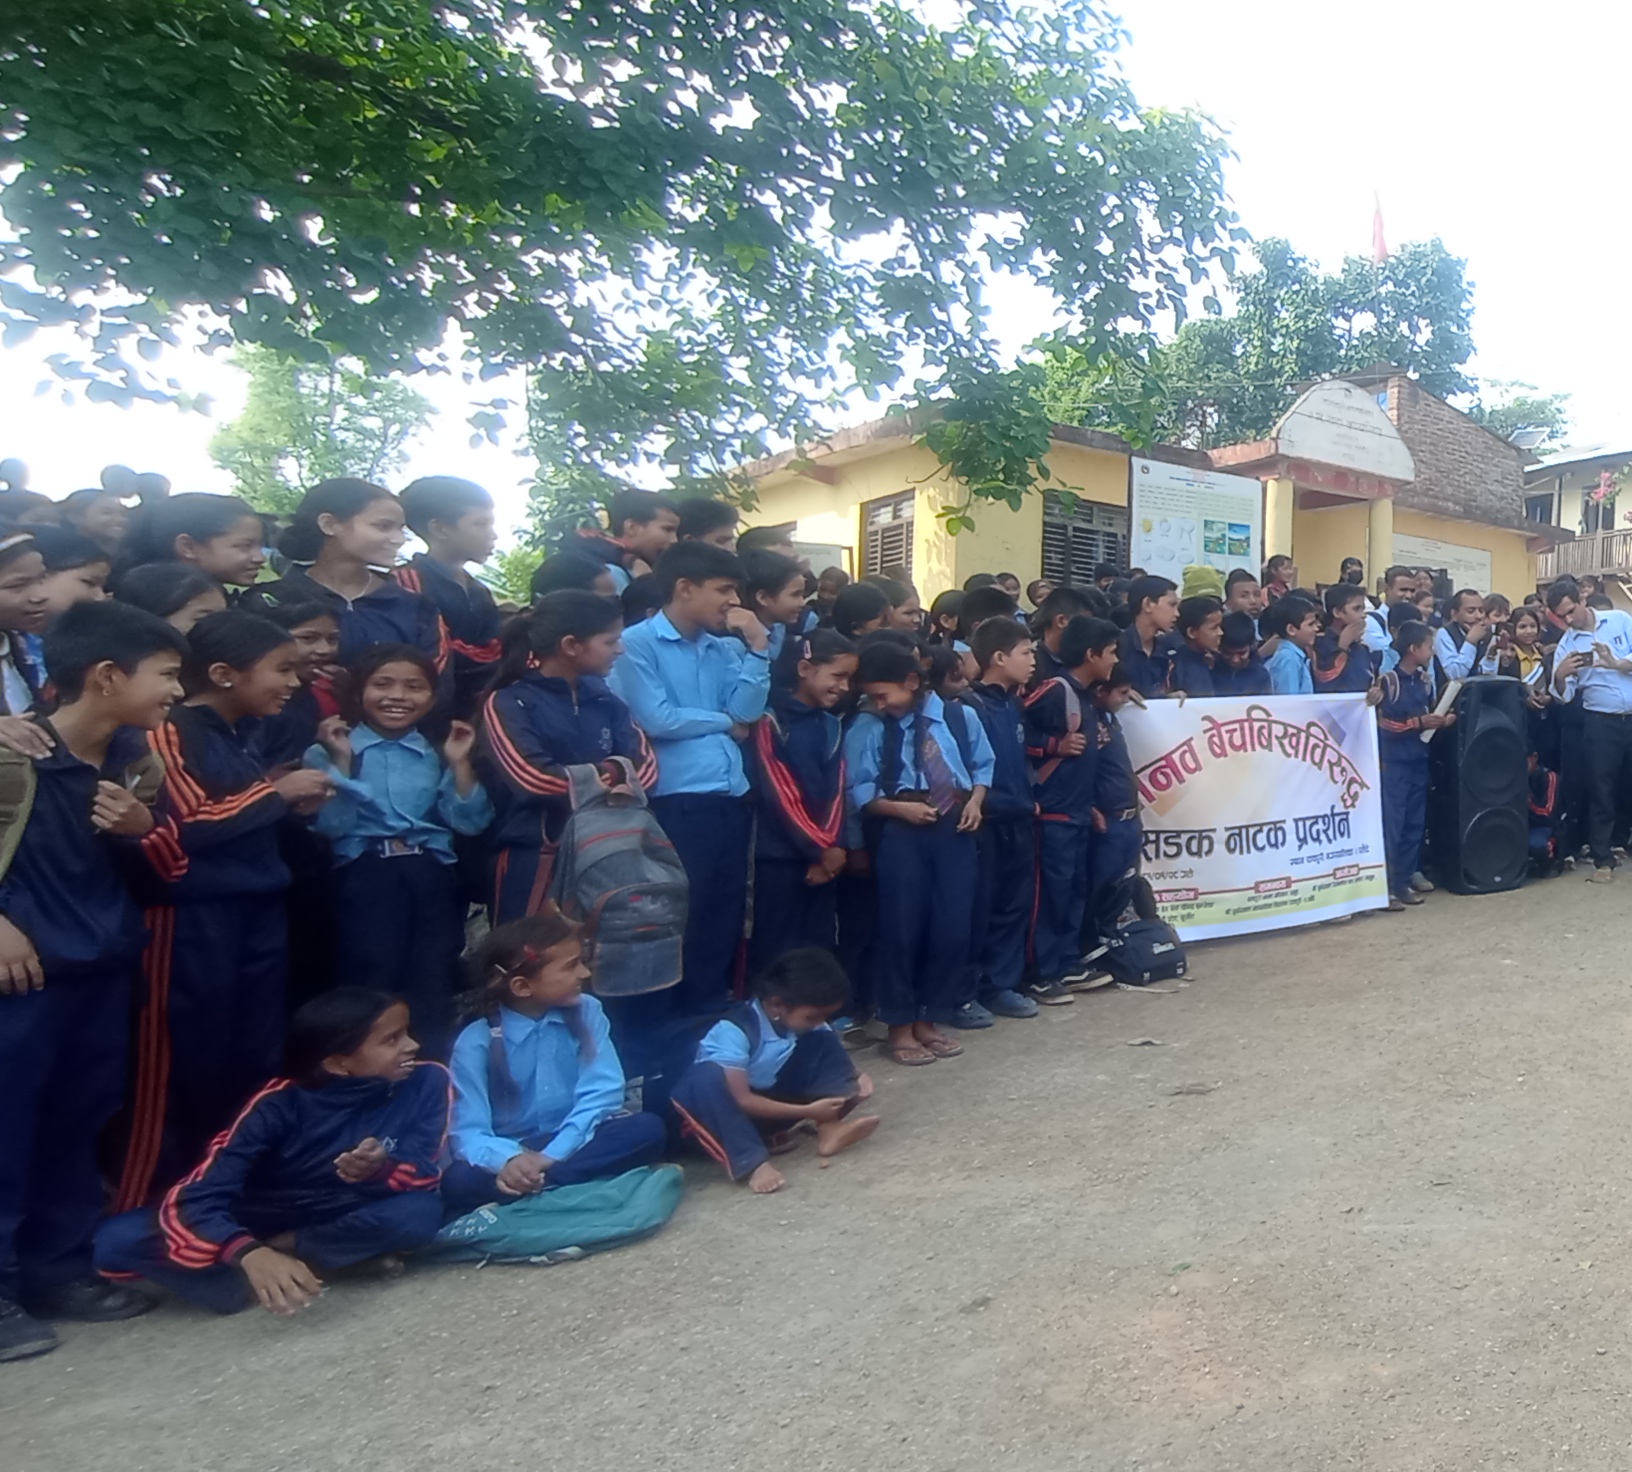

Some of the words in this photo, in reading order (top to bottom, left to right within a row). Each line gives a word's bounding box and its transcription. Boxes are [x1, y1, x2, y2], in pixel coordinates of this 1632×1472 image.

[1135, 736, 1203, 804] ानव
[1141, 828, 1217, 863] सडक
[1223, 818, 1287, 855] नाटक
[1292, 804, 1351, 851] प्रदर्शन
